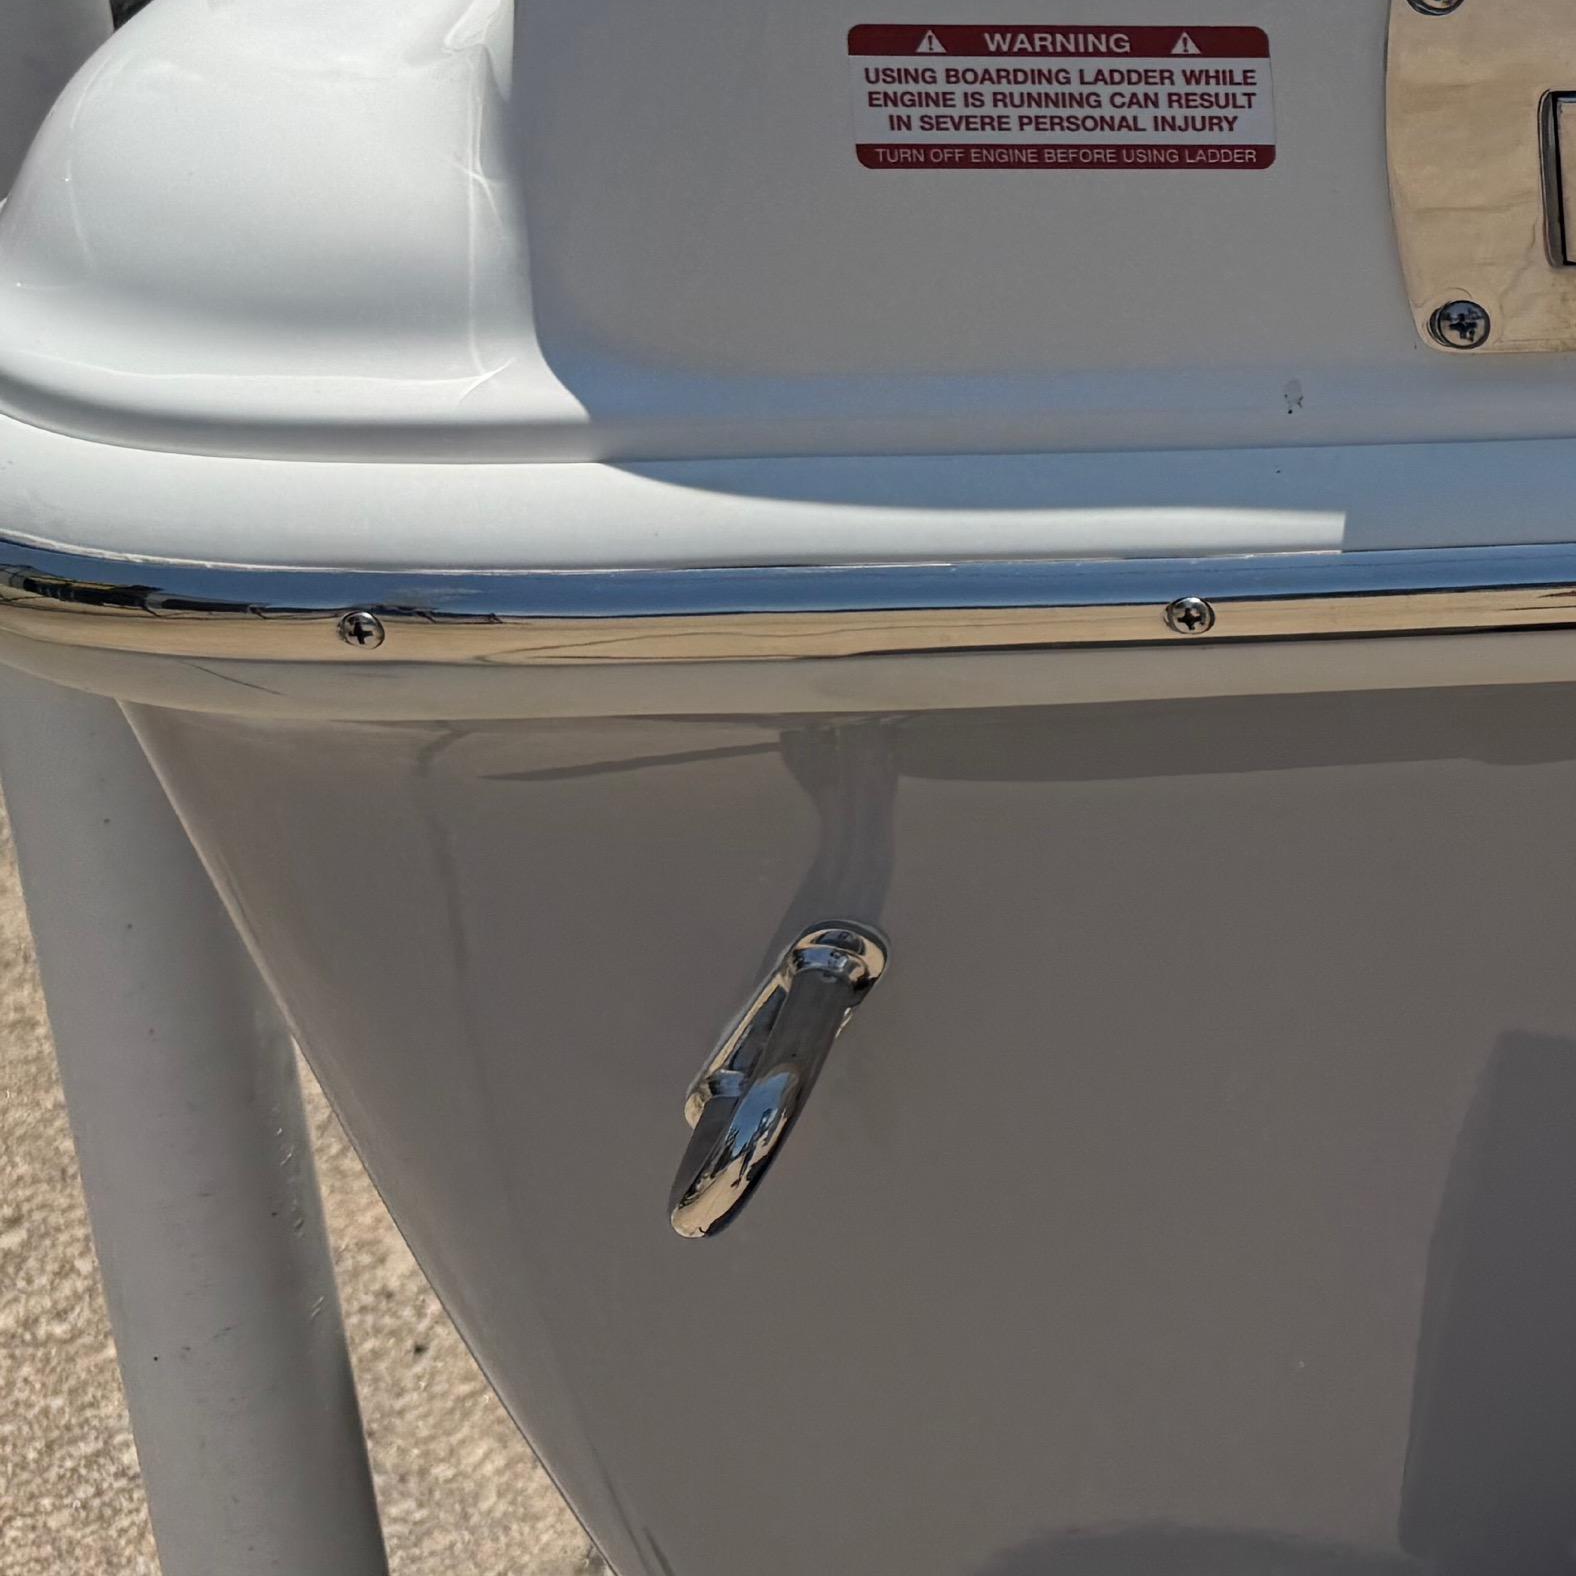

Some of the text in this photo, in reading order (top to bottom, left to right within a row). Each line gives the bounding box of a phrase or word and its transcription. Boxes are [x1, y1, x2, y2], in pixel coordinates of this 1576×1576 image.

[984, 32, 1131, 53] WARNING
[864, 67, 1256, 86] USING BOARDING LADDER WHILE
[868, 91, 1256, 109] ENGINE IS RUNNING CAN RESULT
[889, 115, 1238, 132] IN SEVERE PERSONAL INJURY
[875, 149, 1256, 163] TURN OFF ENGINE BEFORE USING LADDER
